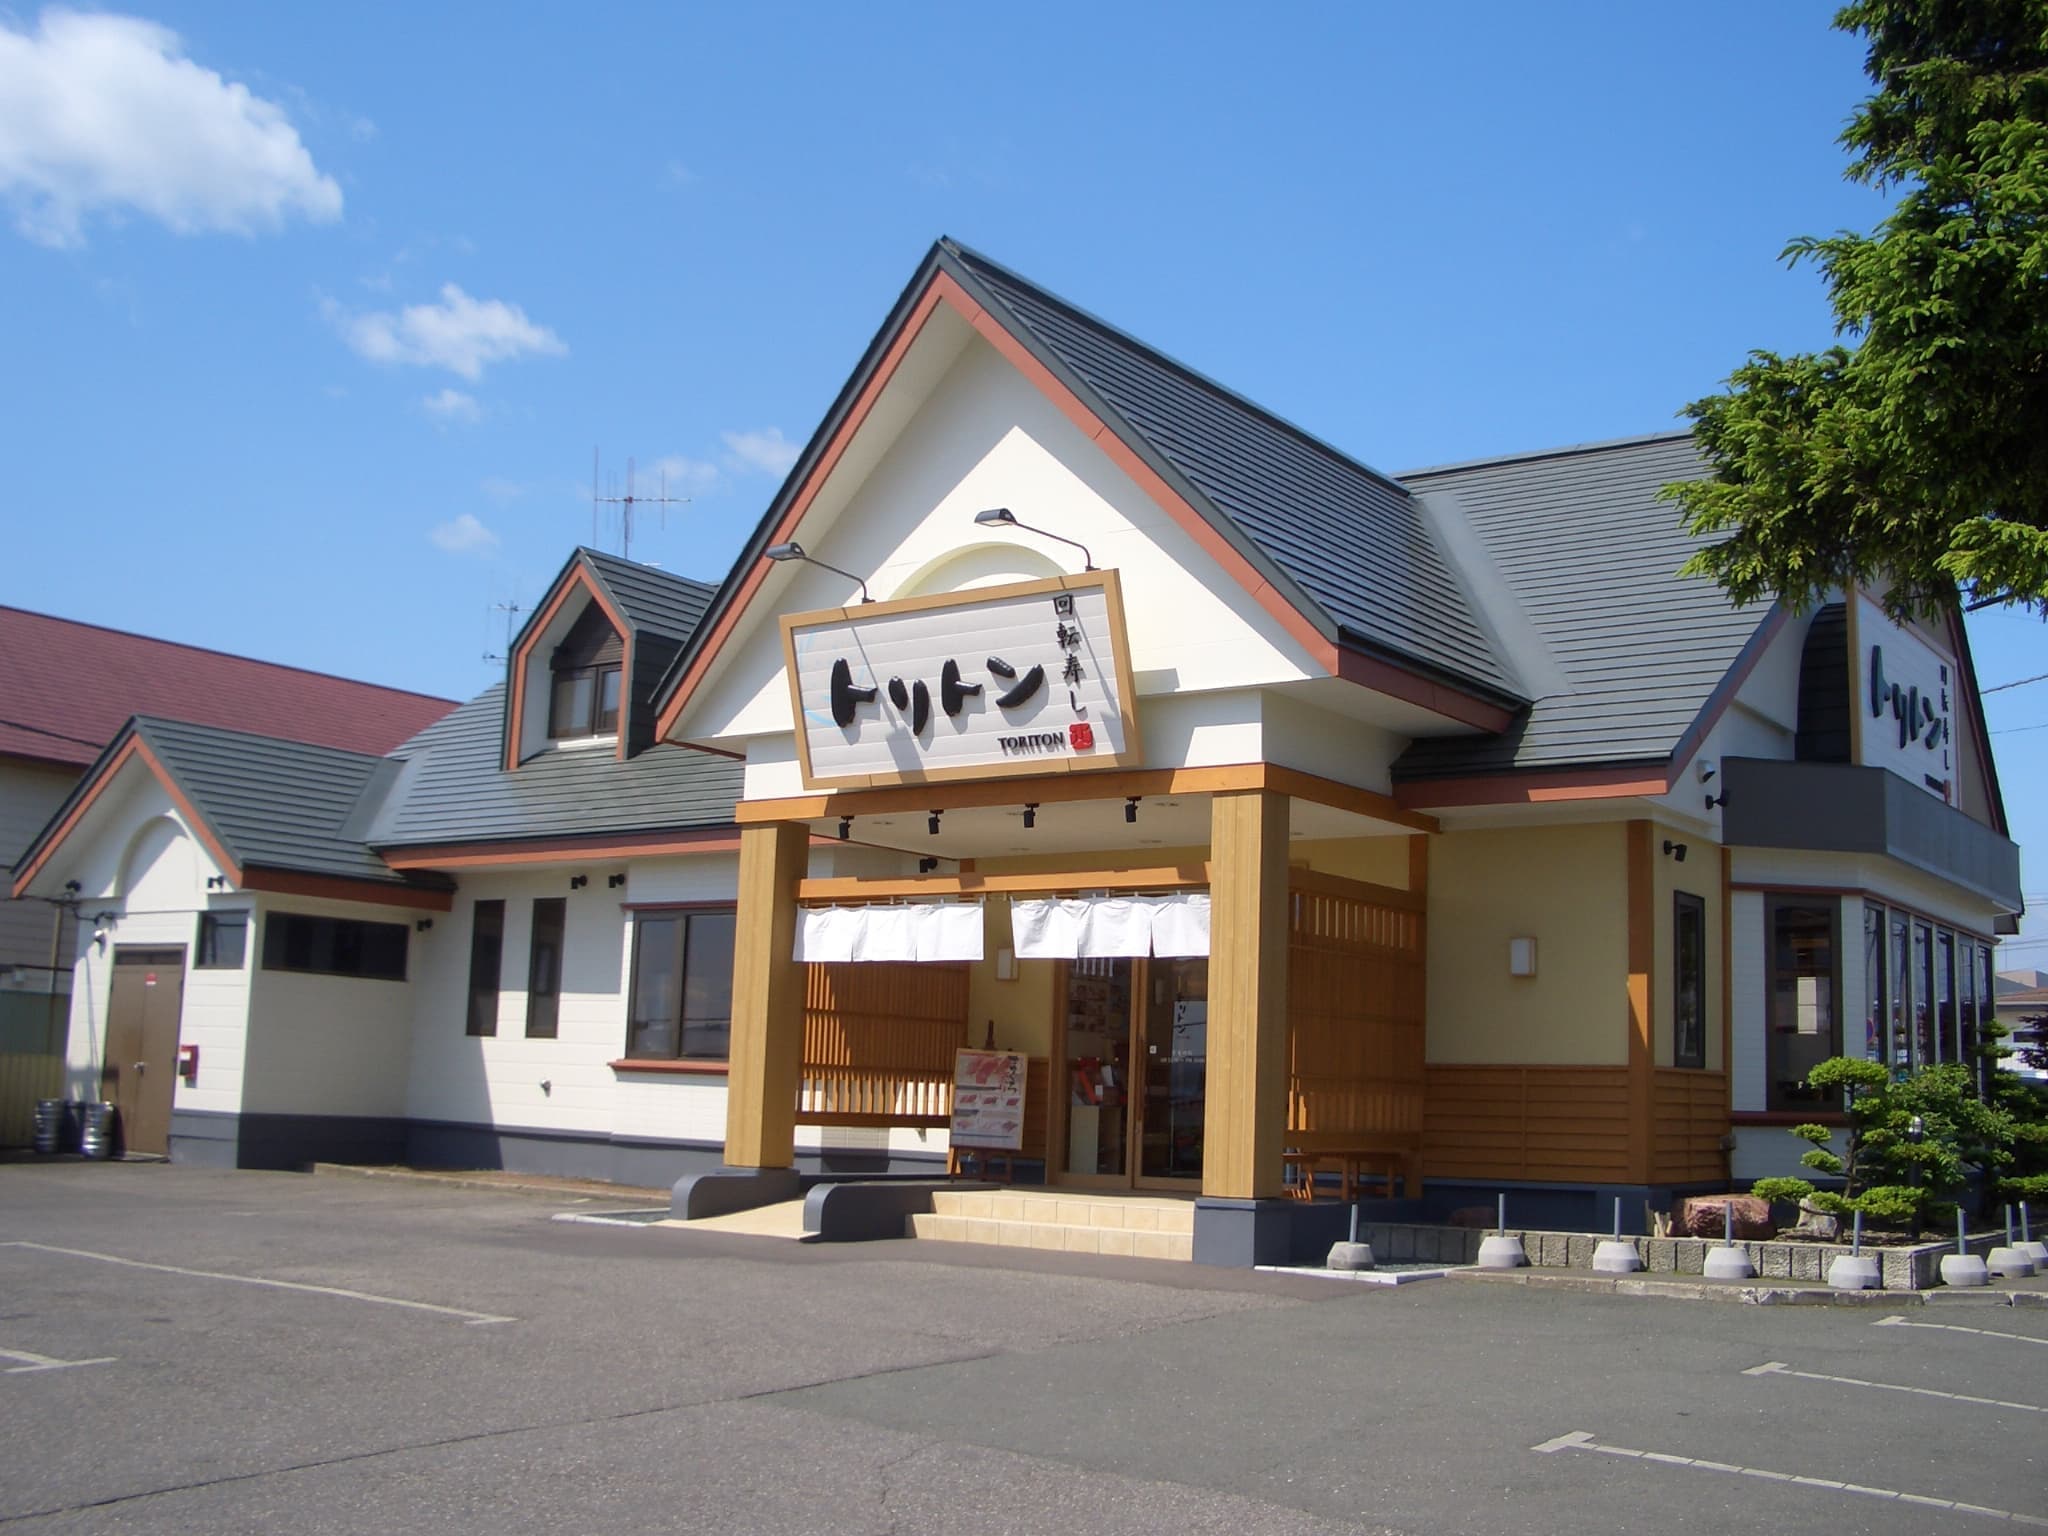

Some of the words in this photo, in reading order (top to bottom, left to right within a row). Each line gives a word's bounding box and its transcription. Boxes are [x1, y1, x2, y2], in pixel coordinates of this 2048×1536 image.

[830, 656, 1045, 736] トリトン
[1053, 593, 1084, 714] 回転寿し
[1871, 645, 1941, 749] トリトン
[997, 731, 1064, 750] TORITON
